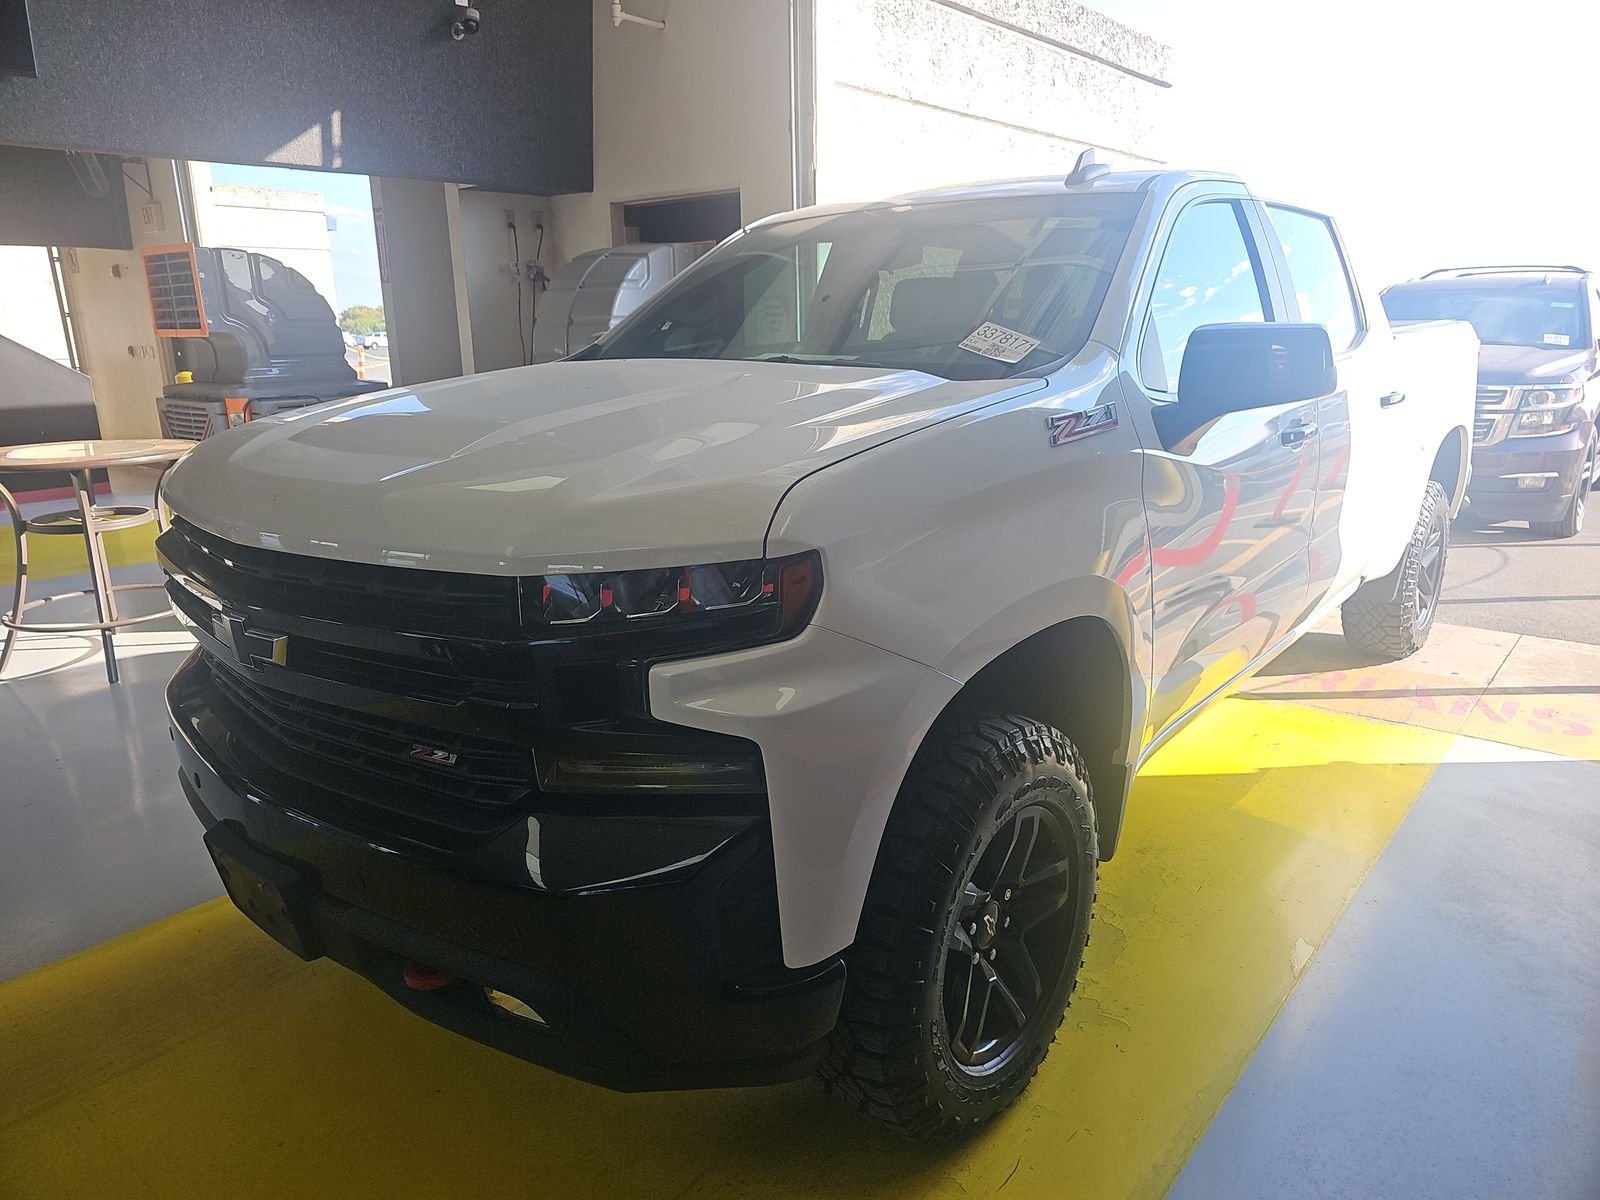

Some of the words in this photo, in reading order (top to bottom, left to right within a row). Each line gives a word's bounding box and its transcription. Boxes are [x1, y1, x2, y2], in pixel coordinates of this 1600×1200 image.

[977, 325, 1037, 353] 3378171
[1046, 401, 1119, 447] Z71
[409, 743, 458, 767] Z71
